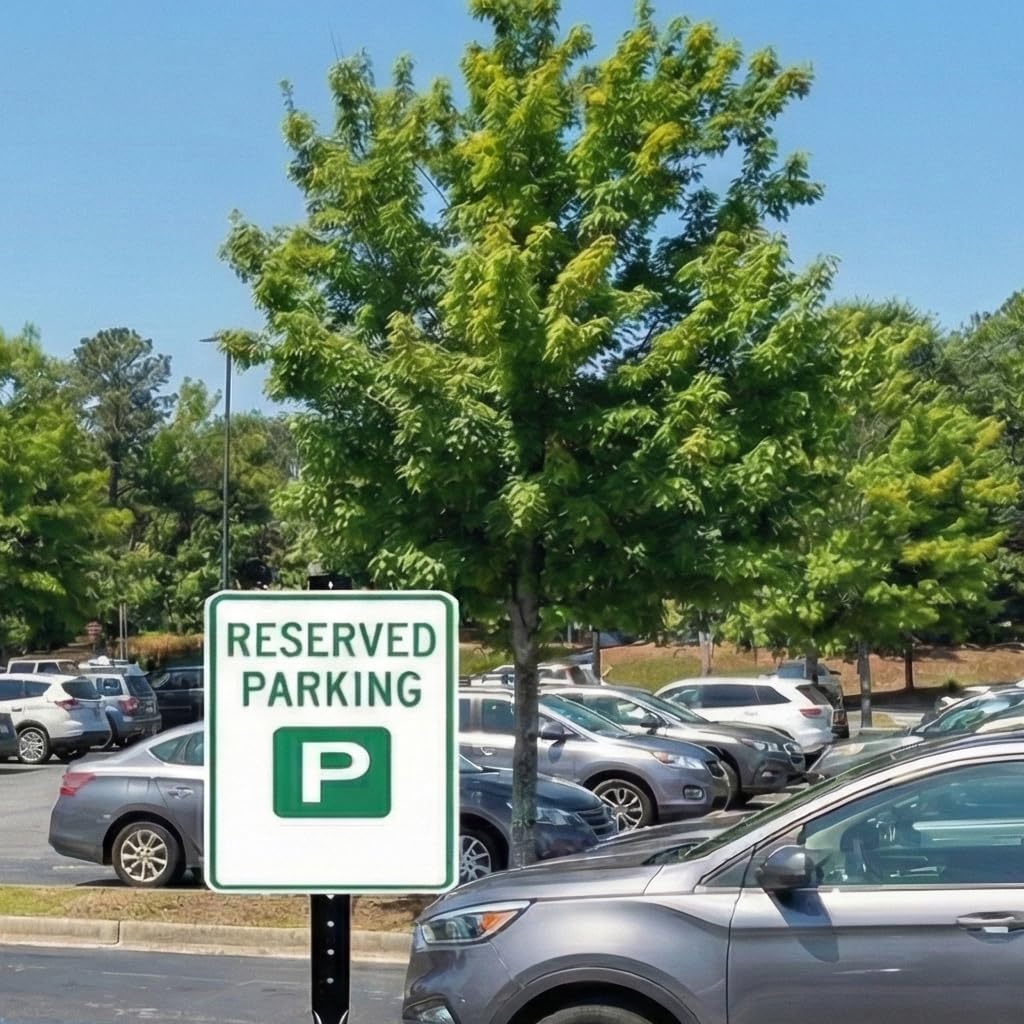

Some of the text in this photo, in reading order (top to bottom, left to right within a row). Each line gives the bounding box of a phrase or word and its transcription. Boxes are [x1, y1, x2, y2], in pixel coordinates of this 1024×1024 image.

[227, 622, 436, 657] RESERVED
[242, 671, 422, 707] PARKING
[302, 742, 370, 802] P
